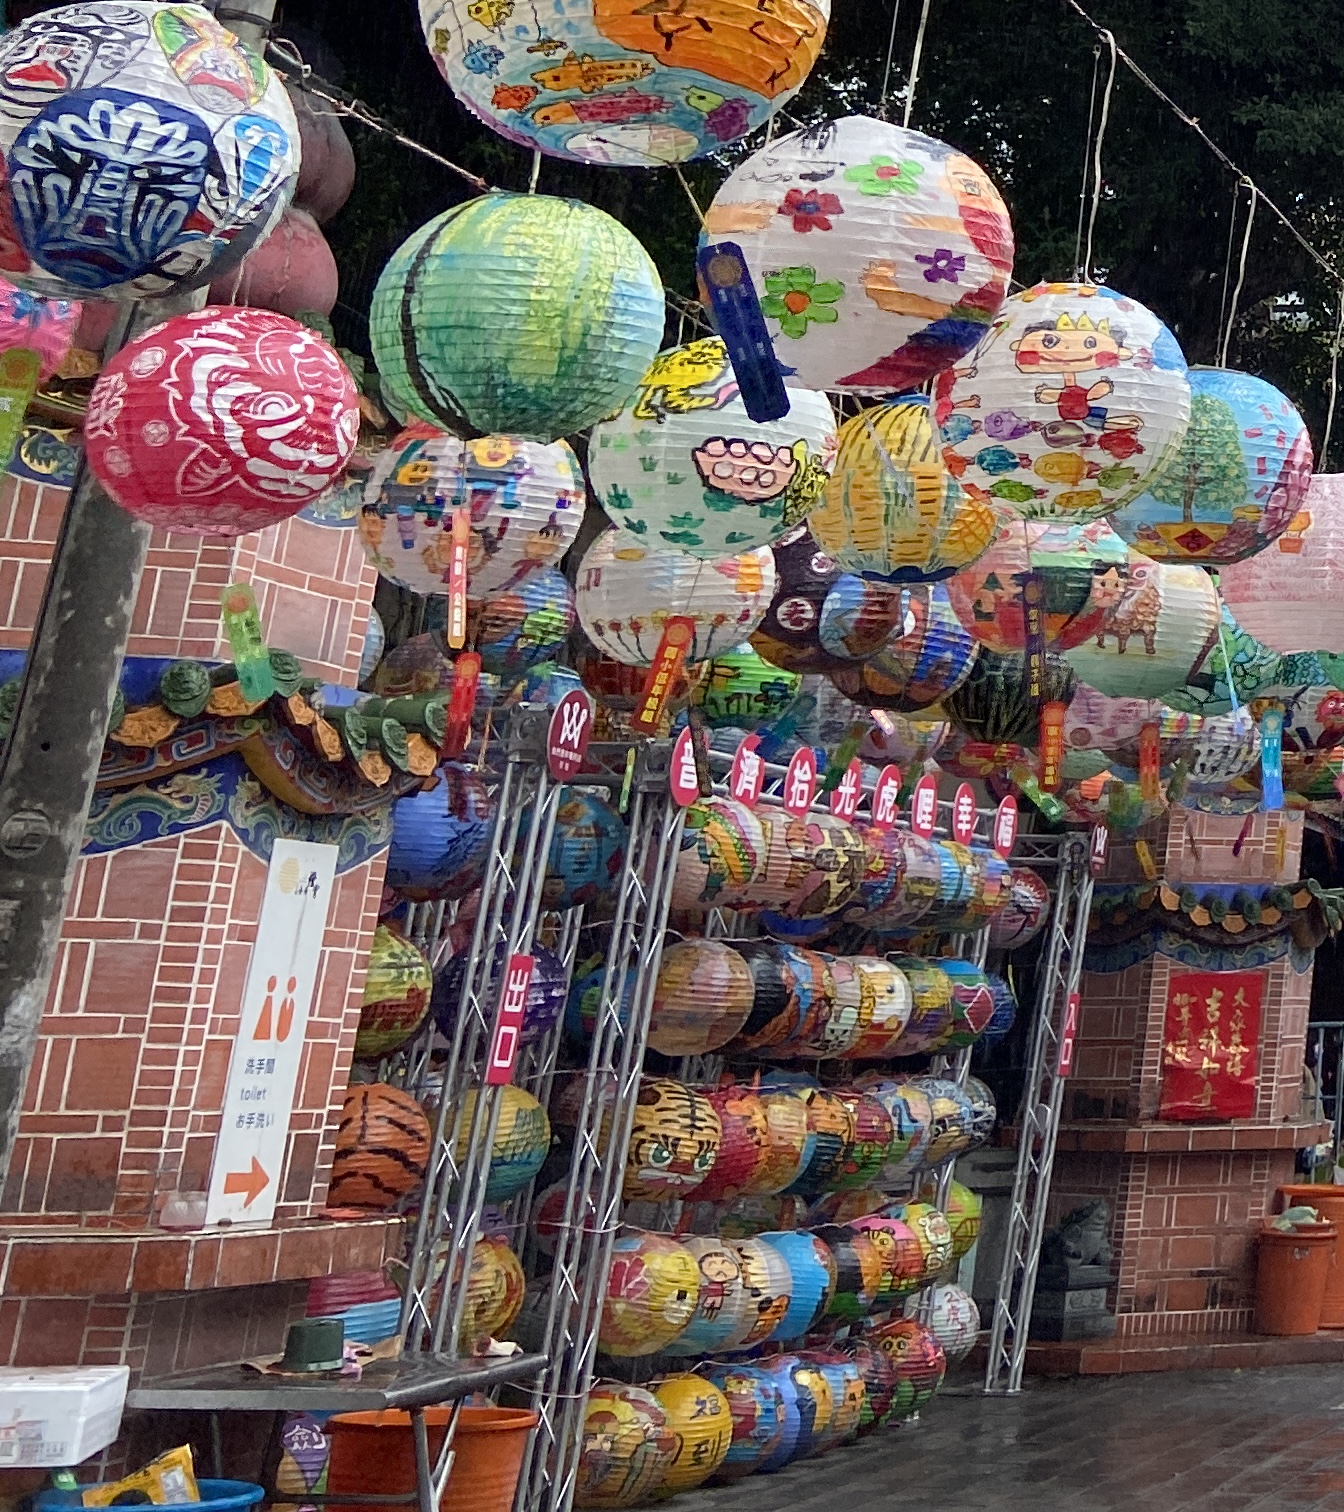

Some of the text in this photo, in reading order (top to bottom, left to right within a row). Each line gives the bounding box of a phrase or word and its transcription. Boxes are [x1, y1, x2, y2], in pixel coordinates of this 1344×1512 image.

[245, 1057, 275, 1075] 洗手間
[240, 1086, 267, 1101] toilet
